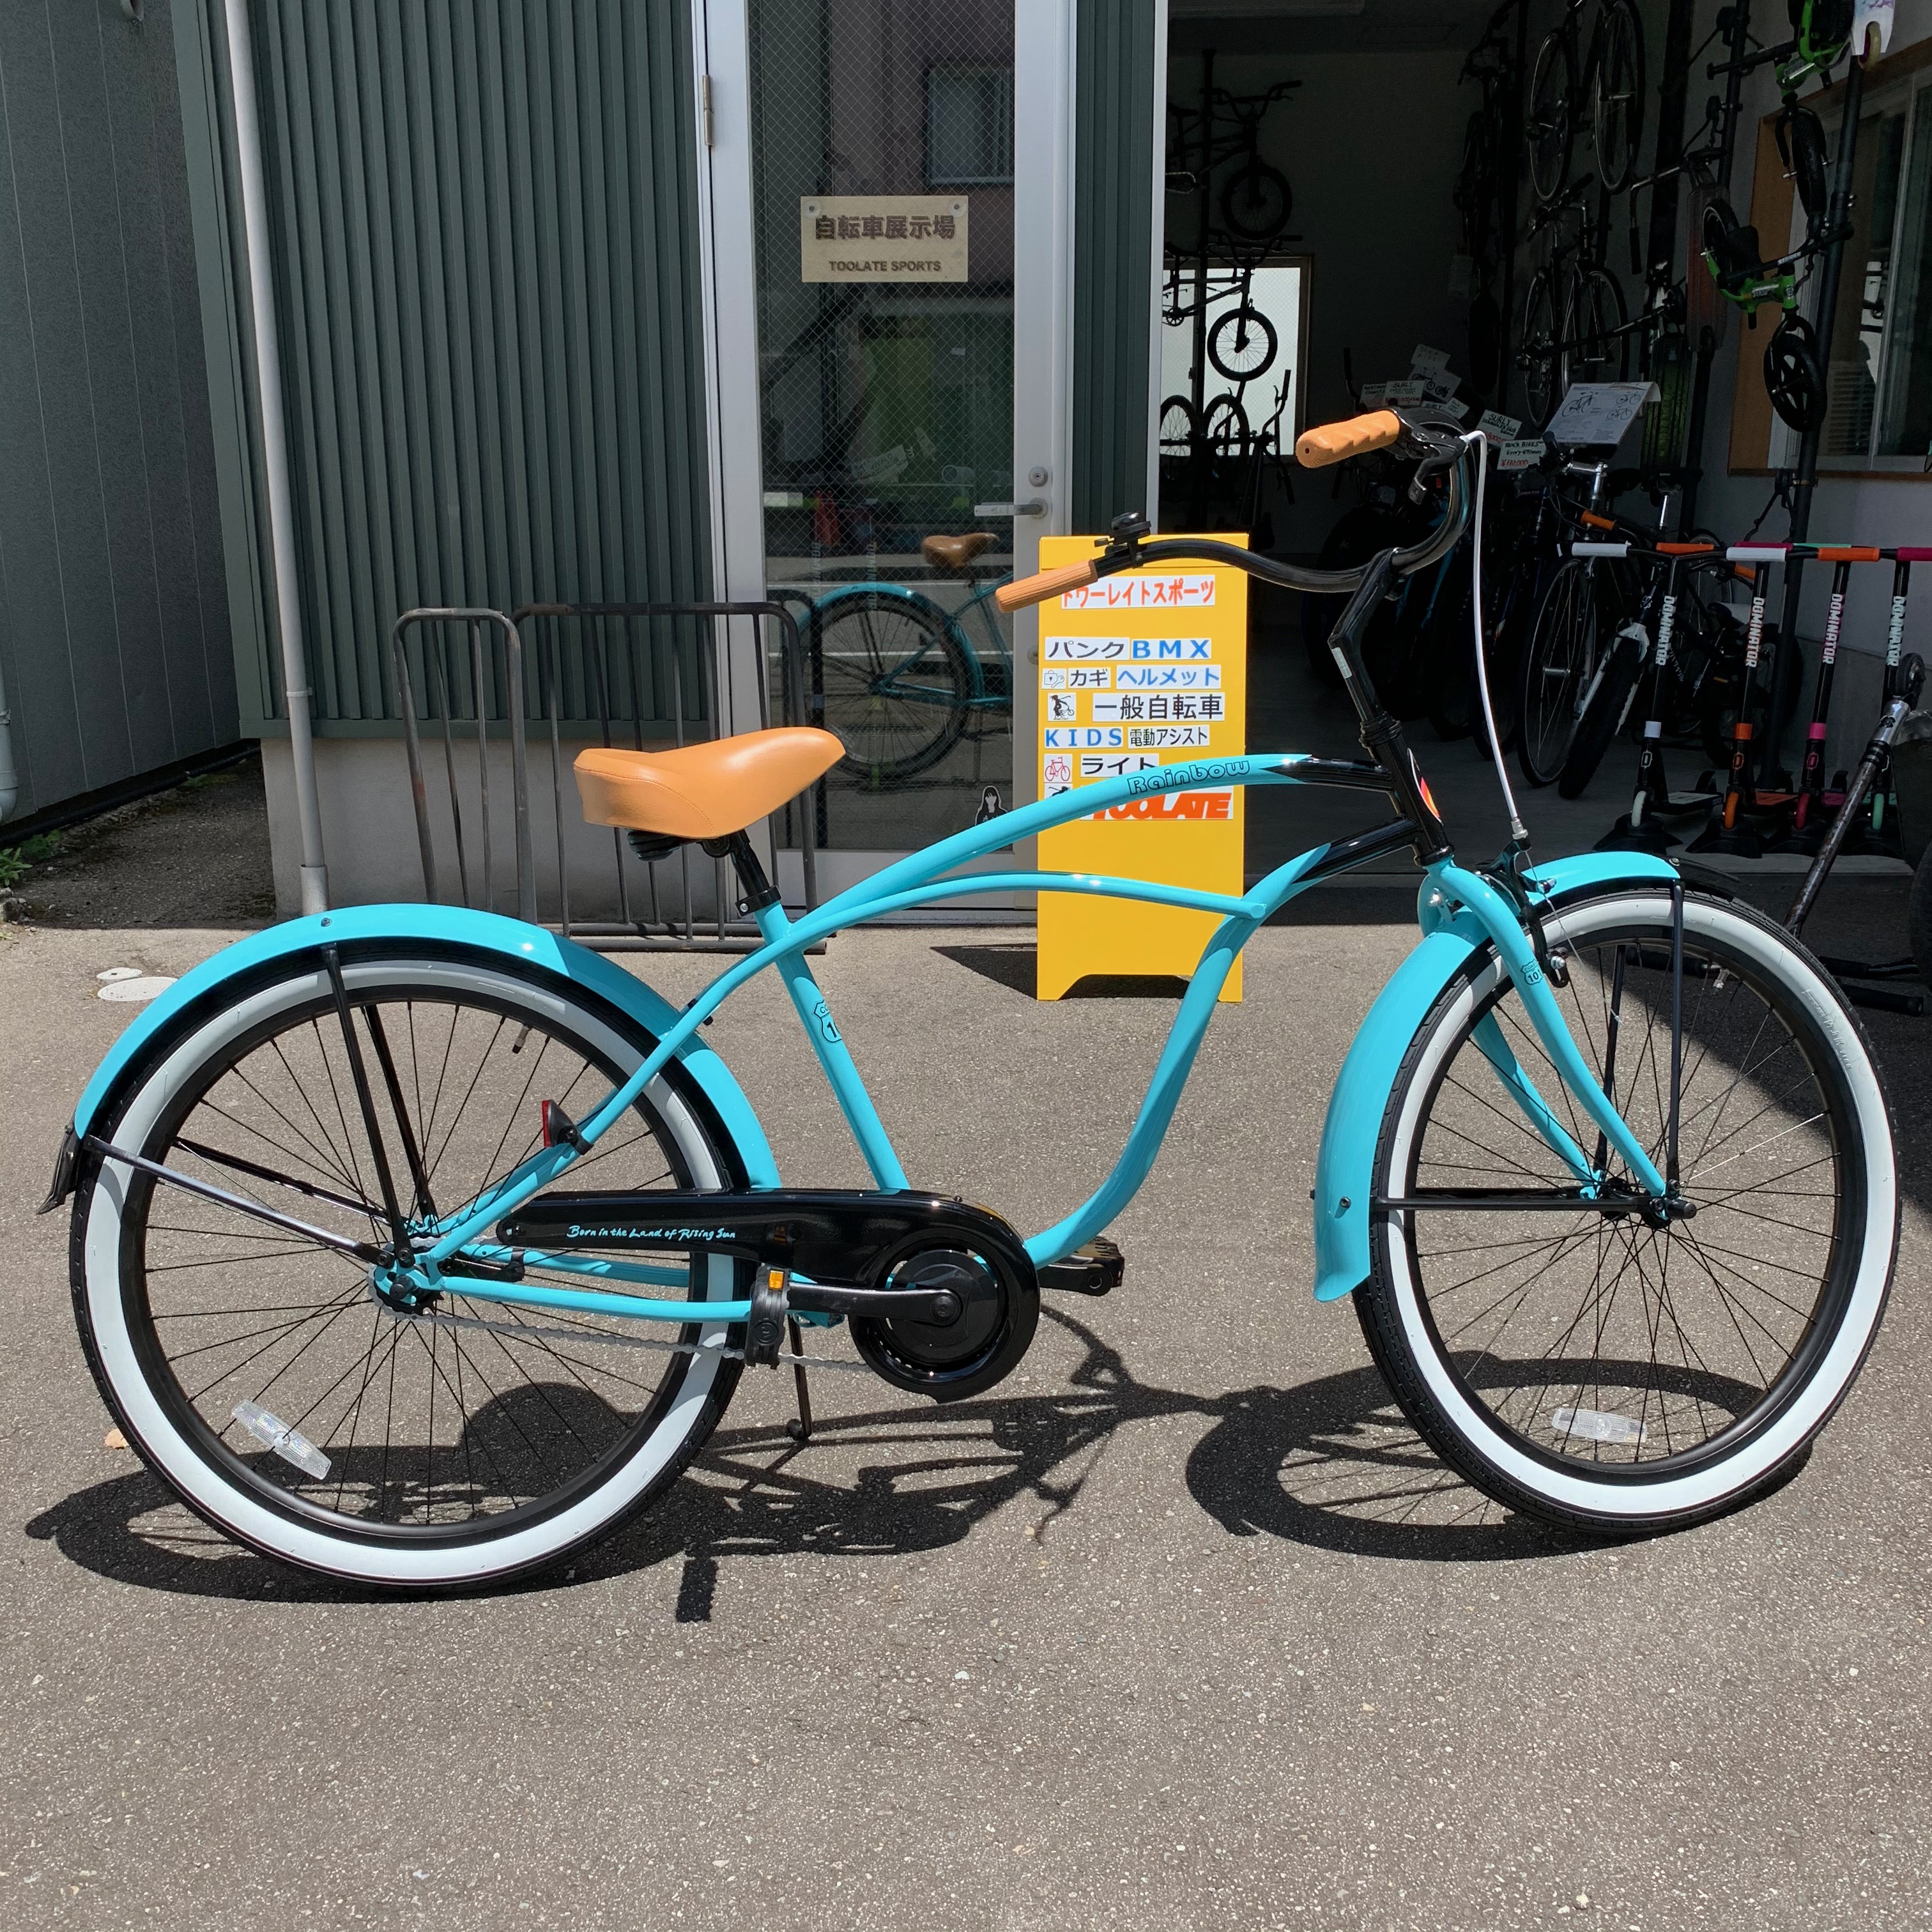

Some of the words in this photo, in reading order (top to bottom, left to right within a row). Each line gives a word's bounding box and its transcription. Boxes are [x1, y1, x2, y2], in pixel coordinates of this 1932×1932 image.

[816, 215, 956, 240] 自転車展示場
[829, 261, 887, 272] TOOLATE
[891, 261, 942, 272] SPORTS
[1489, 413, 1512, 426] SURLY
[1655, 595, 1675, 666] DOMINATOR
[1745, 597, 1766, 668] DOMINATOR
[1822, 593, 1843, 664] DOMINATOR
[1887, 595, 1906, 666] DOMINATOR
[1048, 640, 1125, 659] パンク
[1133, 640, 1210, 659] BMX
[1070, 668, 1108, 687] カギ
[1117, 667, 1220, 687] ヘルメット
[1094, 694, 1223, 720] 一般自転車
[1045, 728, 1123, 747] KIDS
[1130, 727, 1208, 747] 電動アシスト
[1126, 759, 1250, 795] Rainbow
[567, 1225, 597, 1238] Born
[598, 1228, 608, 1236] in
[610, 1228, 627, 1237] the
[629, 1228, 663, 1238] Land
[664, 1229, 677, 1240] of
[678, 1229, 714, 1241] Rising
[716, 1227, 736, 1239] Sun
